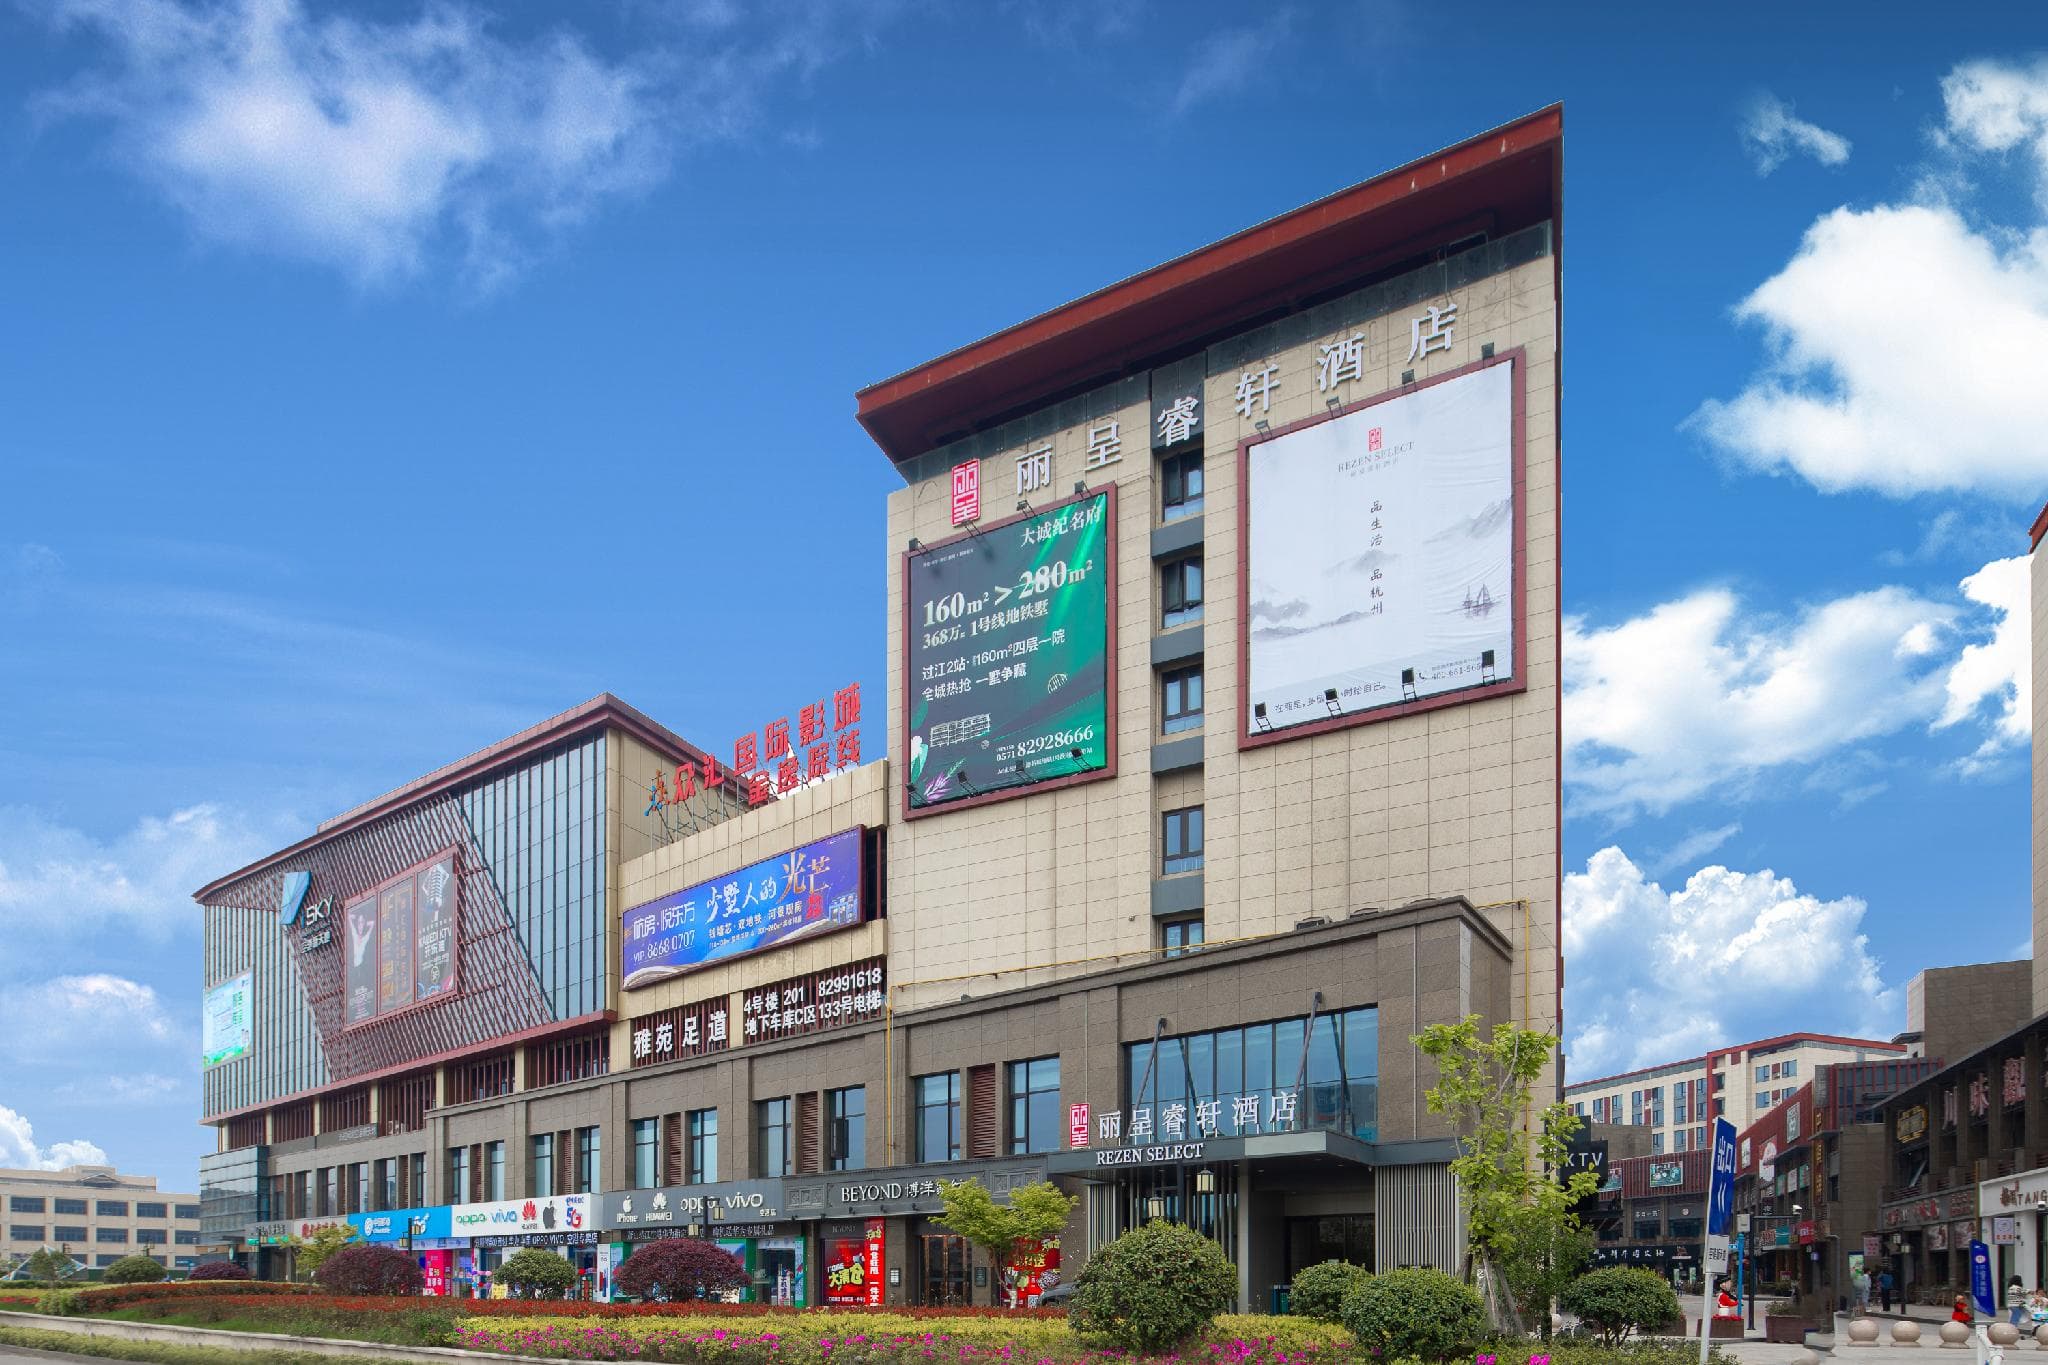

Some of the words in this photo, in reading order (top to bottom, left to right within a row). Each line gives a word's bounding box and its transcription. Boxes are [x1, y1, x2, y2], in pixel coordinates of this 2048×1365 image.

[1016, 303, 1457, 497] 丽呈睿轩酒店
[1017, 724, 1093, 757] 82928666
[996, 751, 1015, 762] 0571
[744, 991, 779, 1014] 4号楼
[783, 986, 804, 1006] 201
[818, 967, 882, 997] 82991618
[634, 1010, 727, 1059] 雅苑足道
[1098, 1091, 1297, 1140] 丽呈睿轩酒店
[1096, 1148, 1142, 1166] REZEN
[1146, 1142, 1204, 1162] SELECT
[1565, 1152, 1602, 1167] KTV
[726, 1192, 764, 1208] vivo
[841, 1183, 902, 1202] BEYOND
[491, 1208, 518, 1223] vivo
[566, 1207, 582, 1228] 5G
[645, 1212, 673, 1222] HUAWEI
